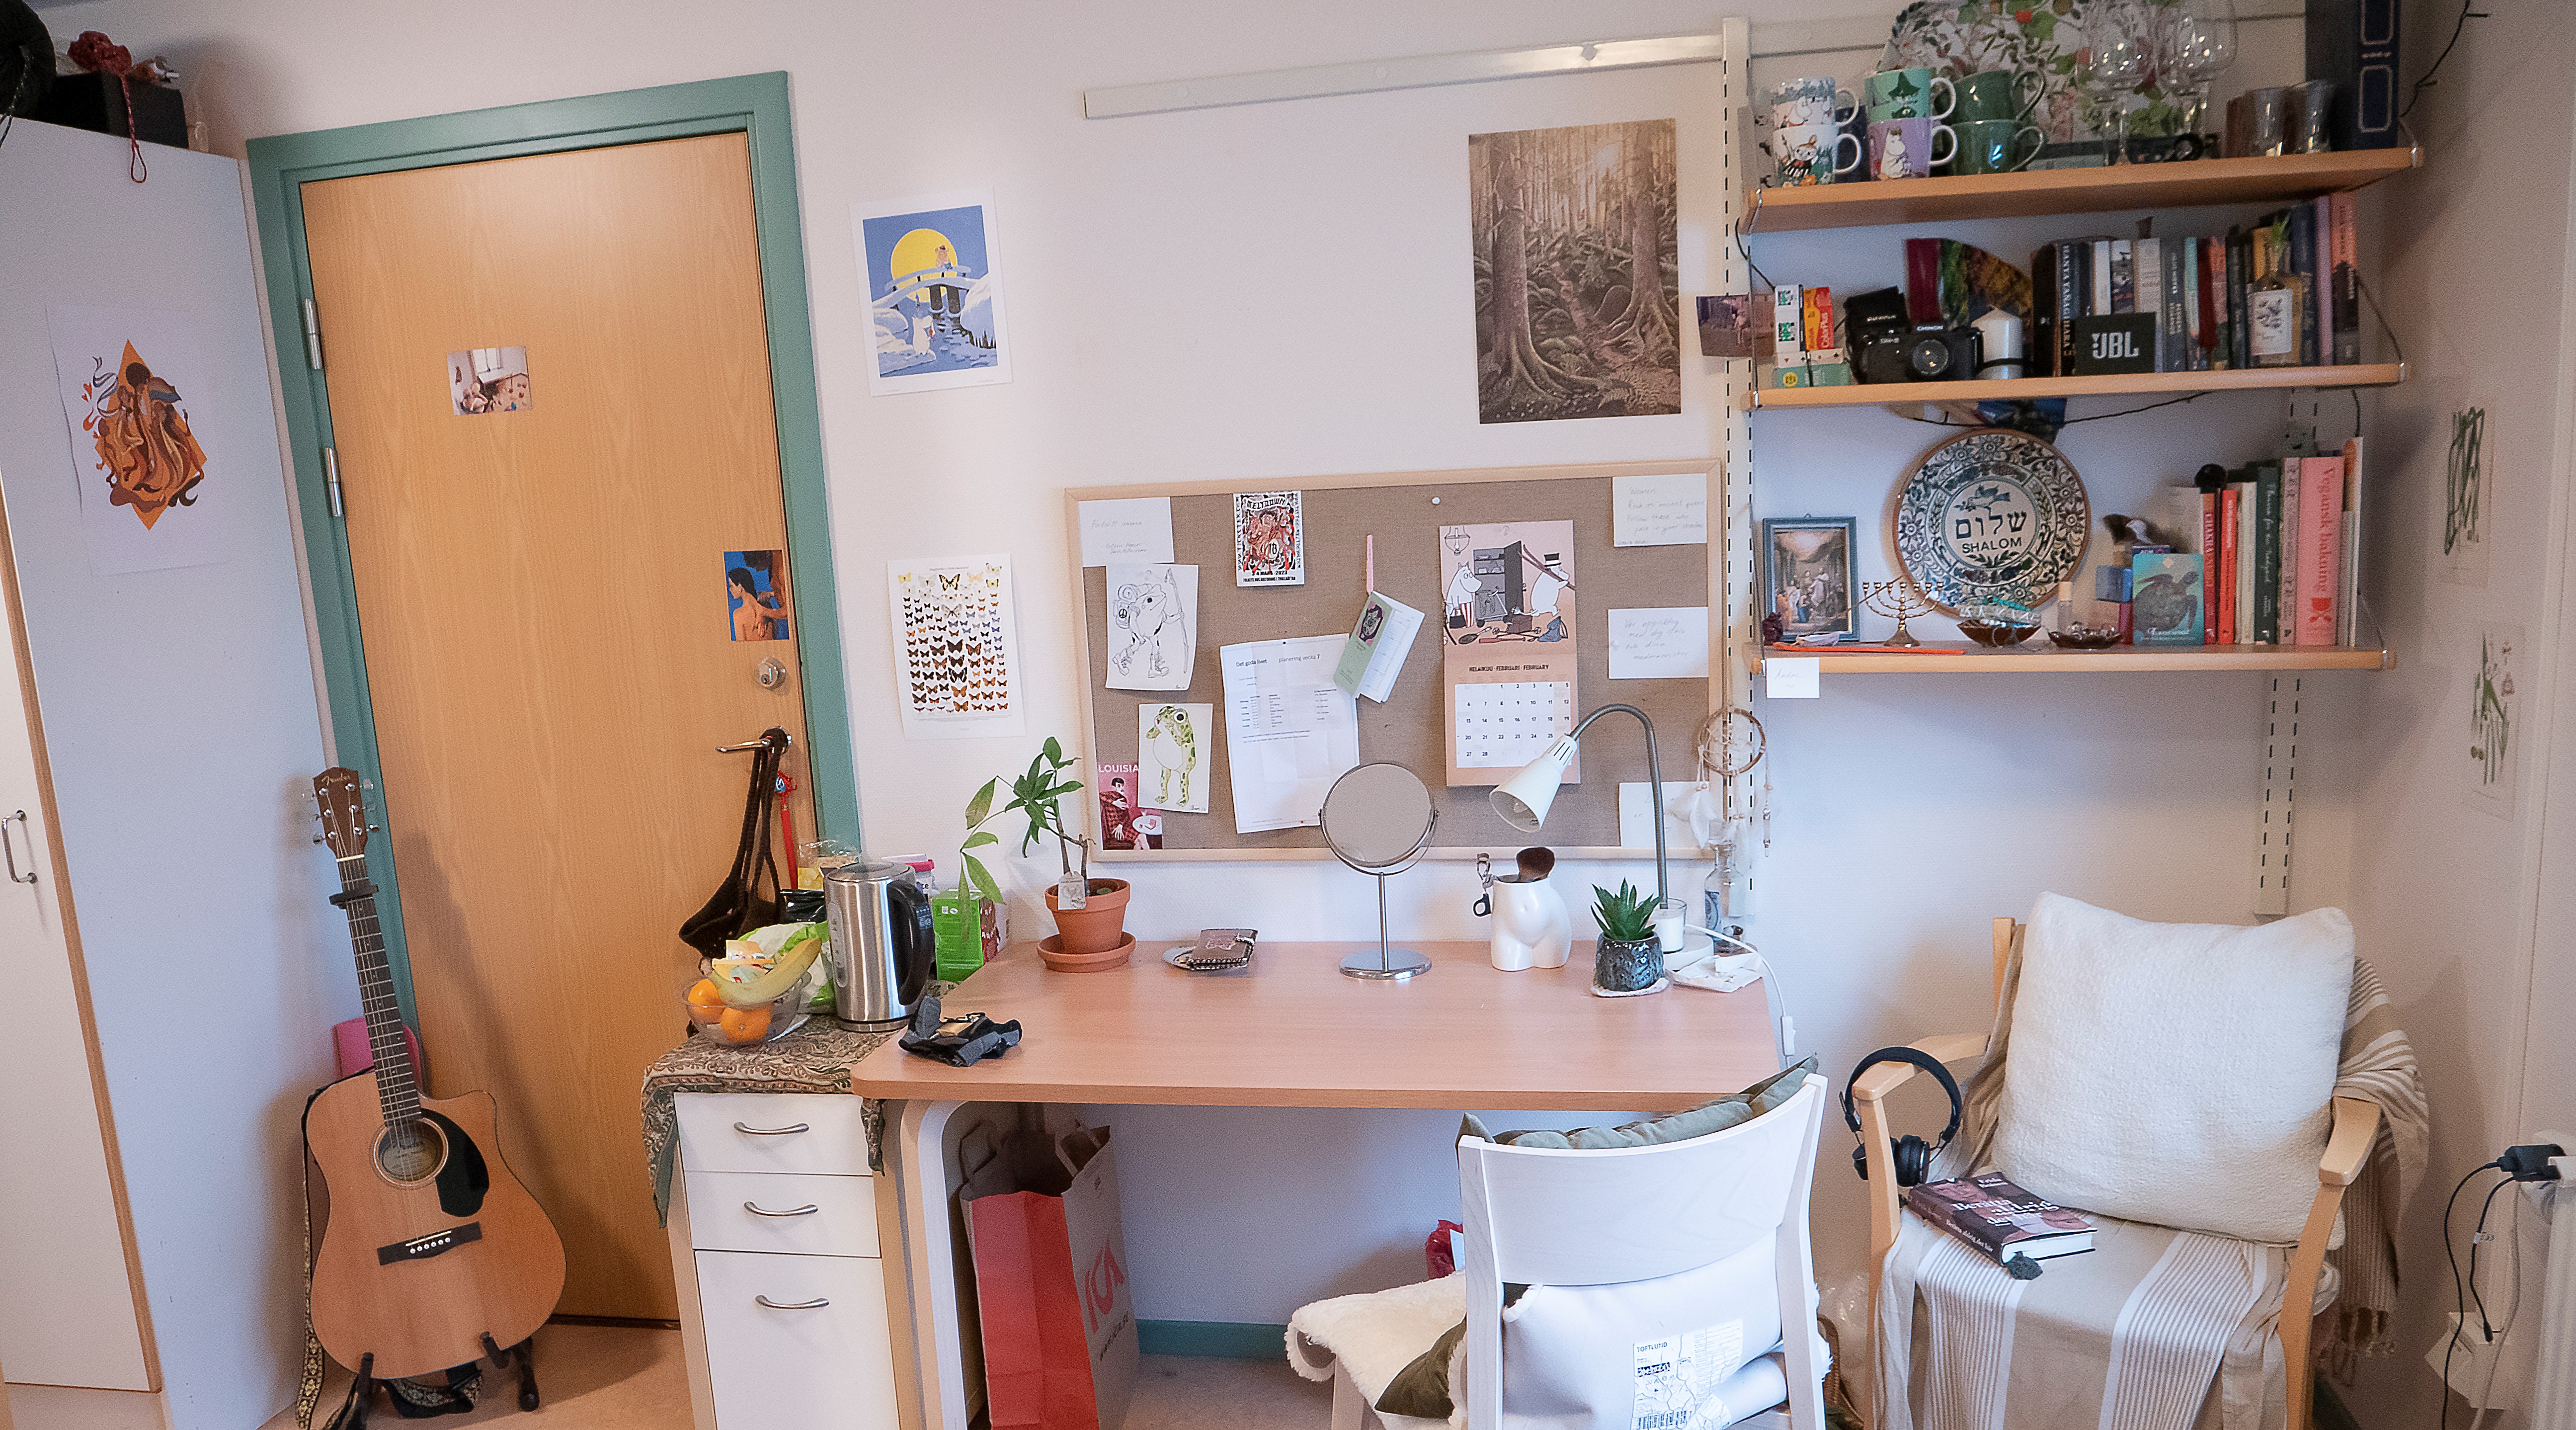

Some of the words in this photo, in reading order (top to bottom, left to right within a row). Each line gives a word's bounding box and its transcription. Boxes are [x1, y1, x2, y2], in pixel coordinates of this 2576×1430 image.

[2092, 332, 2139, 359] JBL
[1247, 498, 1286, 509] MELTDOWN
[2318, 466, 2335, 529] Vegansk
[1956, 507, 2027, 539] שלום
[2204, 512, 2214, 553] CHAKRA
[1962, 537, 2022, 553] SHALOM
[2315, 532, 2333, 592] bakning
[321, 773, 350, 786] Fender
[1951, 1199, 2013, 1211] Berätta
[1991, 1200, 2060, 1214] aldrig
[1988, 1216, 2012, 1225] det
[1946, 1219, 1962, 1233] Berätta
[1962, 1230, 1976, 1243] aldrig
[1085, 1236, 1125, 1334] ICA
[1636, 1342, 1668, 1352] TOFTLUND
